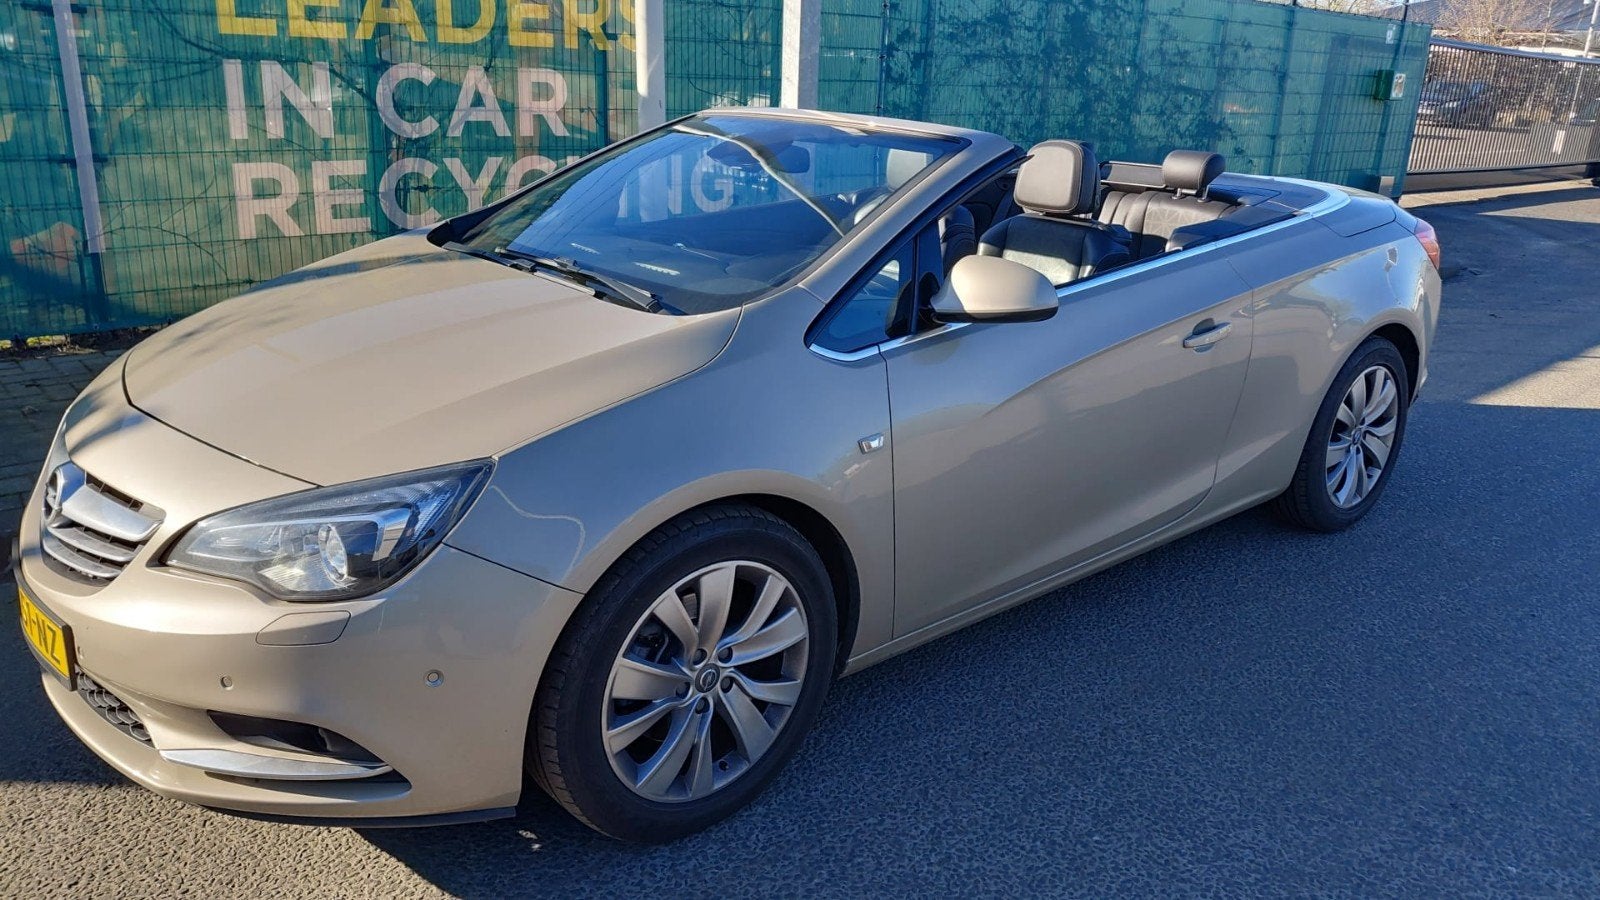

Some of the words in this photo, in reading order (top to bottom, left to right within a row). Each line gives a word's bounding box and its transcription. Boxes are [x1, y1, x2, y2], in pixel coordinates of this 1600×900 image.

[223, 58, 335, 140] IN
[376, 62, 570, 139] CAR
[232, 155, 733, 240] RECYG
